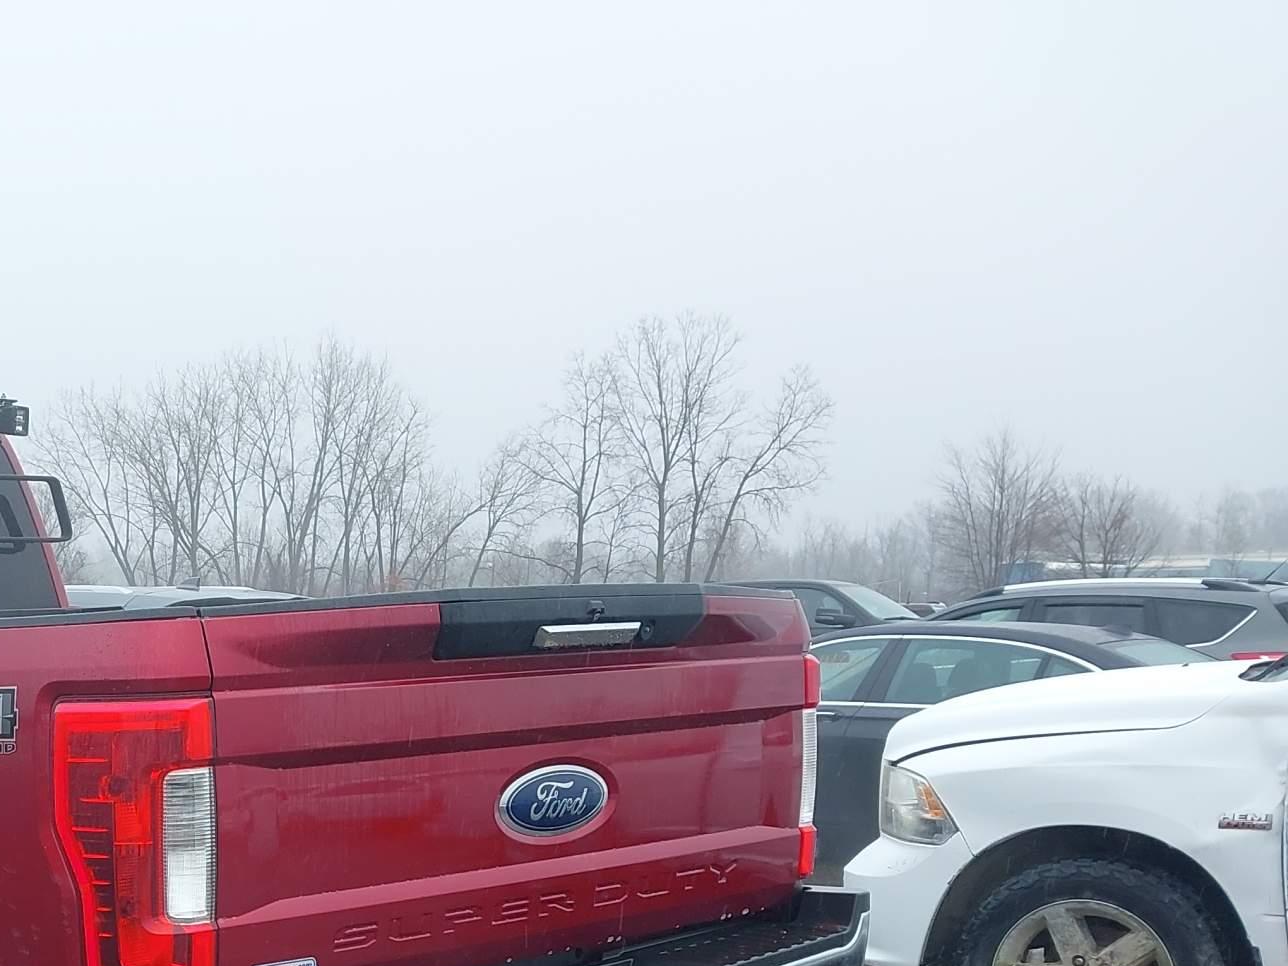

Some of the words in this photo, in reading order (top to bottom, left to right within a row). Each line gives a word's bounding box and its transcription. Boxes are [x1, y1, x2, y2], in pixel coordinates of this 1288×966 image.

[530, 781, 588, 821] Ford
[333, 893, 575, 953] SUPER
[593, 863, 738, 908] DUTY
